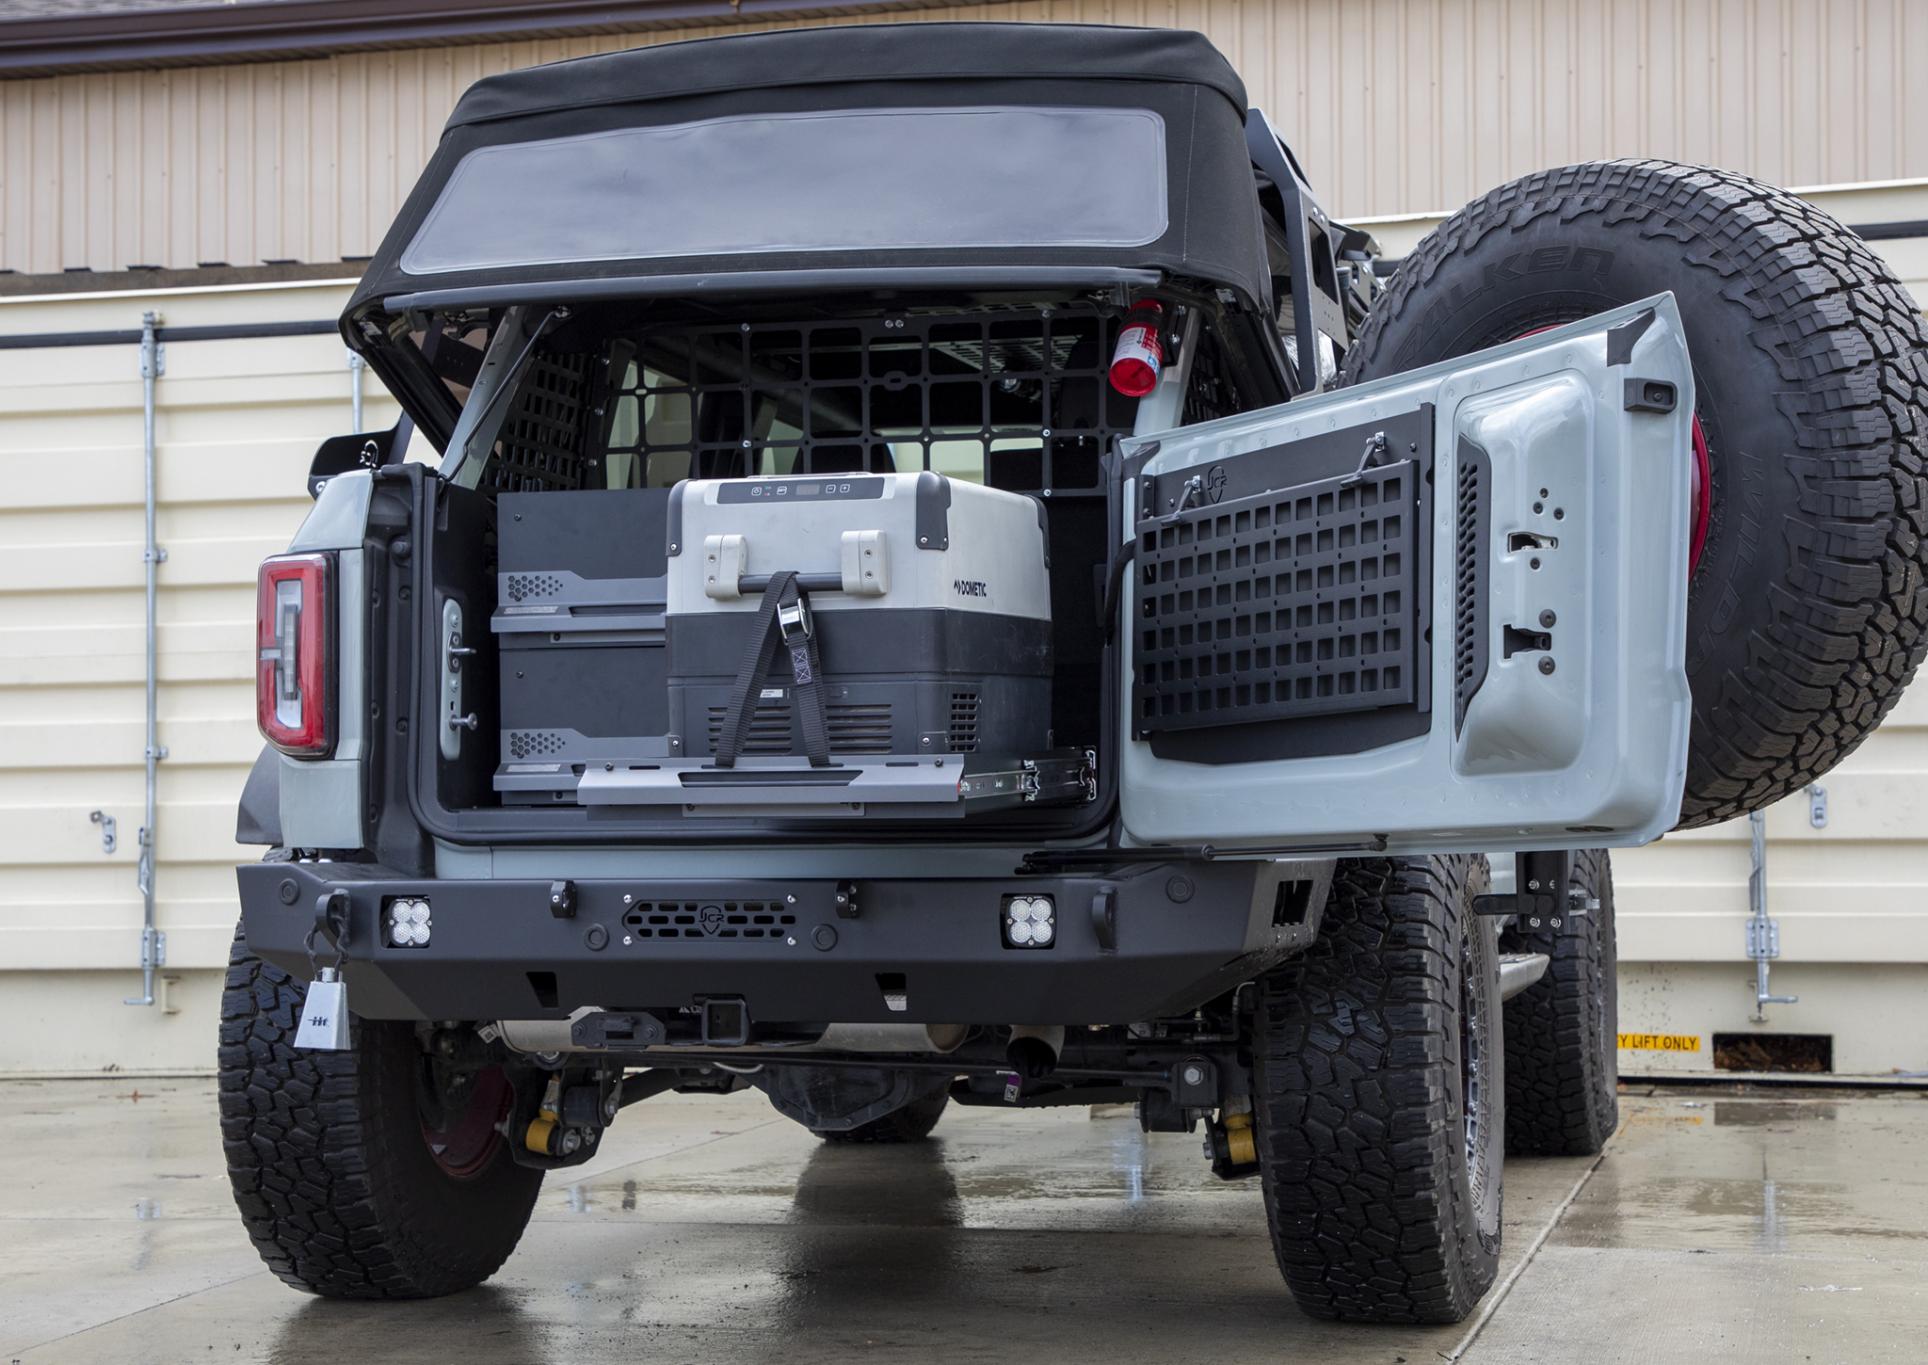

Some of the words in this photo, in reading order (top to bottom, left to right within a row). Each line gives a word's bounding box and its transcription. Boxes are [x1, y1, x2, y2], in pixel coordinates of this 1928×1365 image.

[961, 580, 987, 597] DOMETIC
[1632, 1035, 1659, 1049] LIFT
[1663, 1036, 1697, 1051] ONLY
